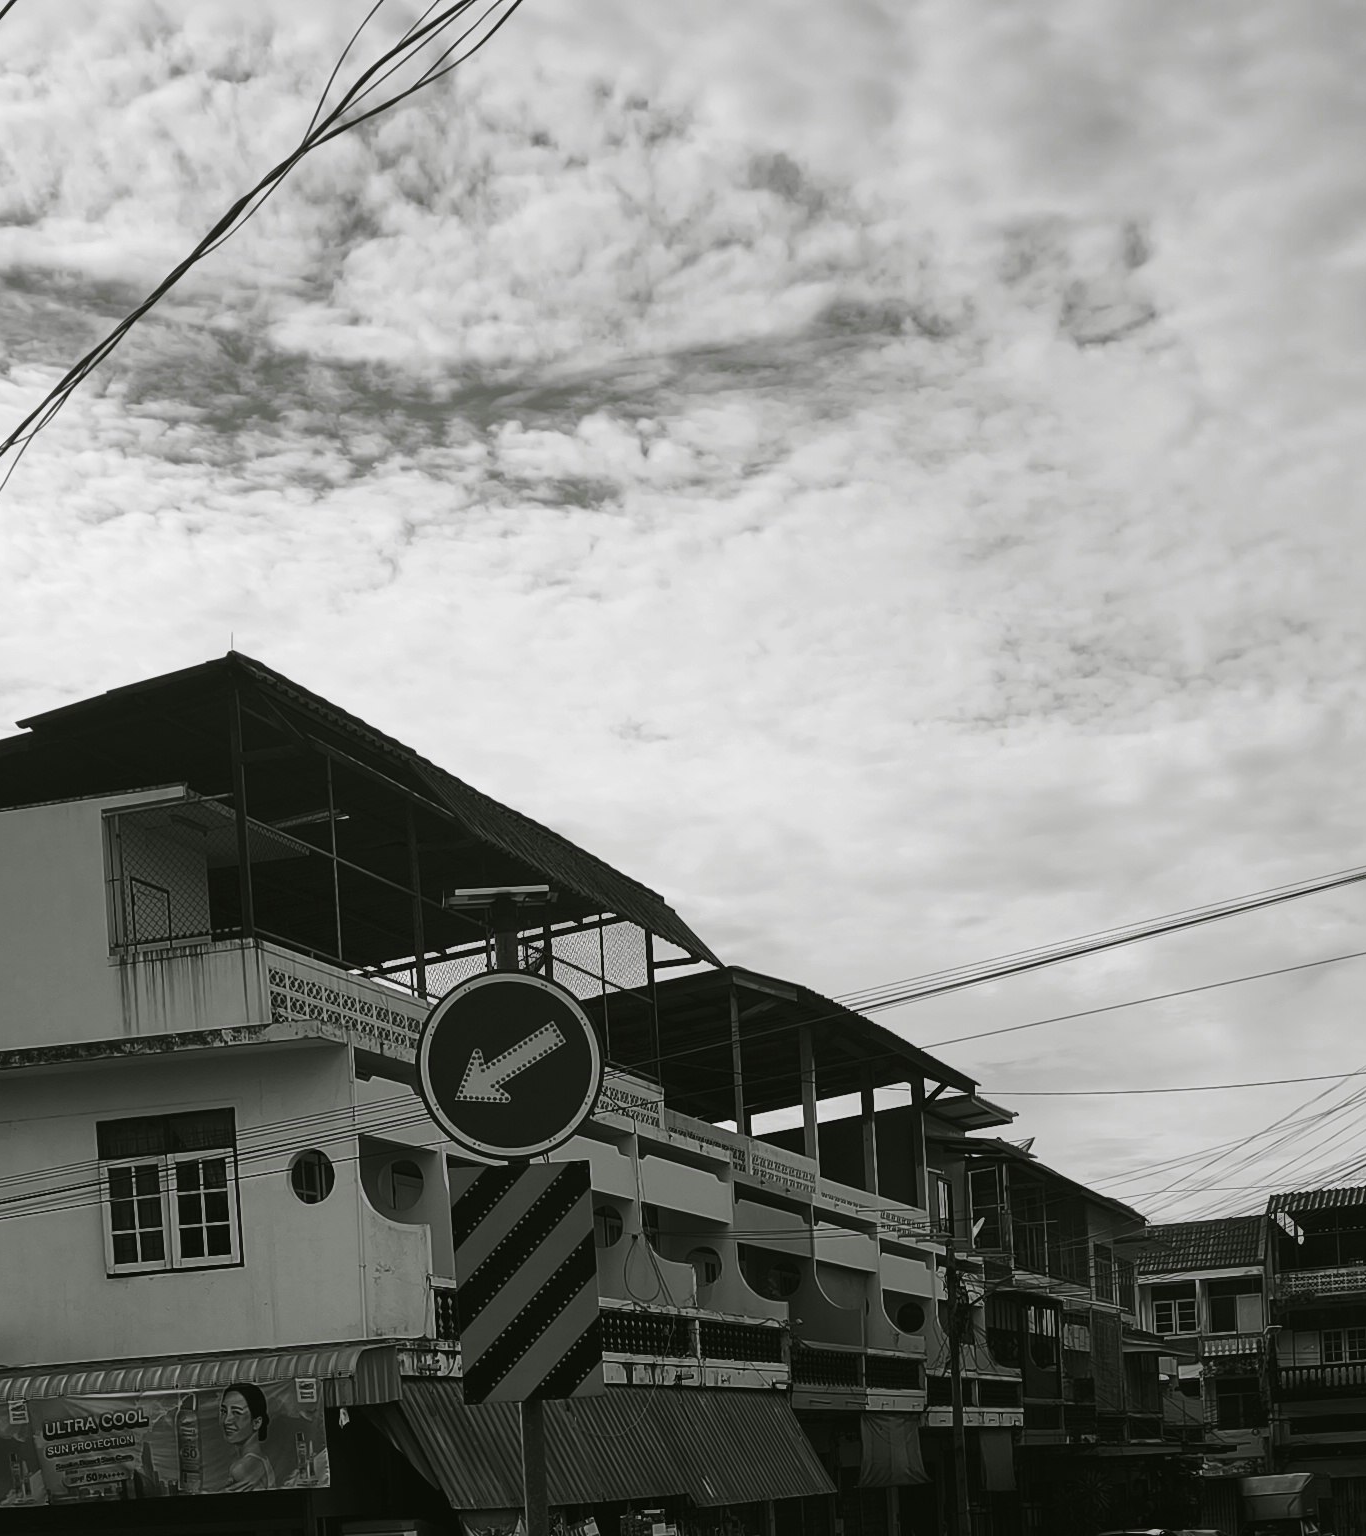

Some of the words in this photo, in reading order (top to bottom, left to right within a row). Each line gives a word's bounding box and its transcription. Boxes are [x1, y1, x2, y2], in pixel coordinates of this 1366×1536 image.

[44, 1416, 97, 1436] ULTRA
[101, 1409, 148, 1427] COOL
[47, 1444, 69, 1456] SUN
[71, 1435, 134, 1452] PROTECTION
[86, 1472, 98, 1482] 50
